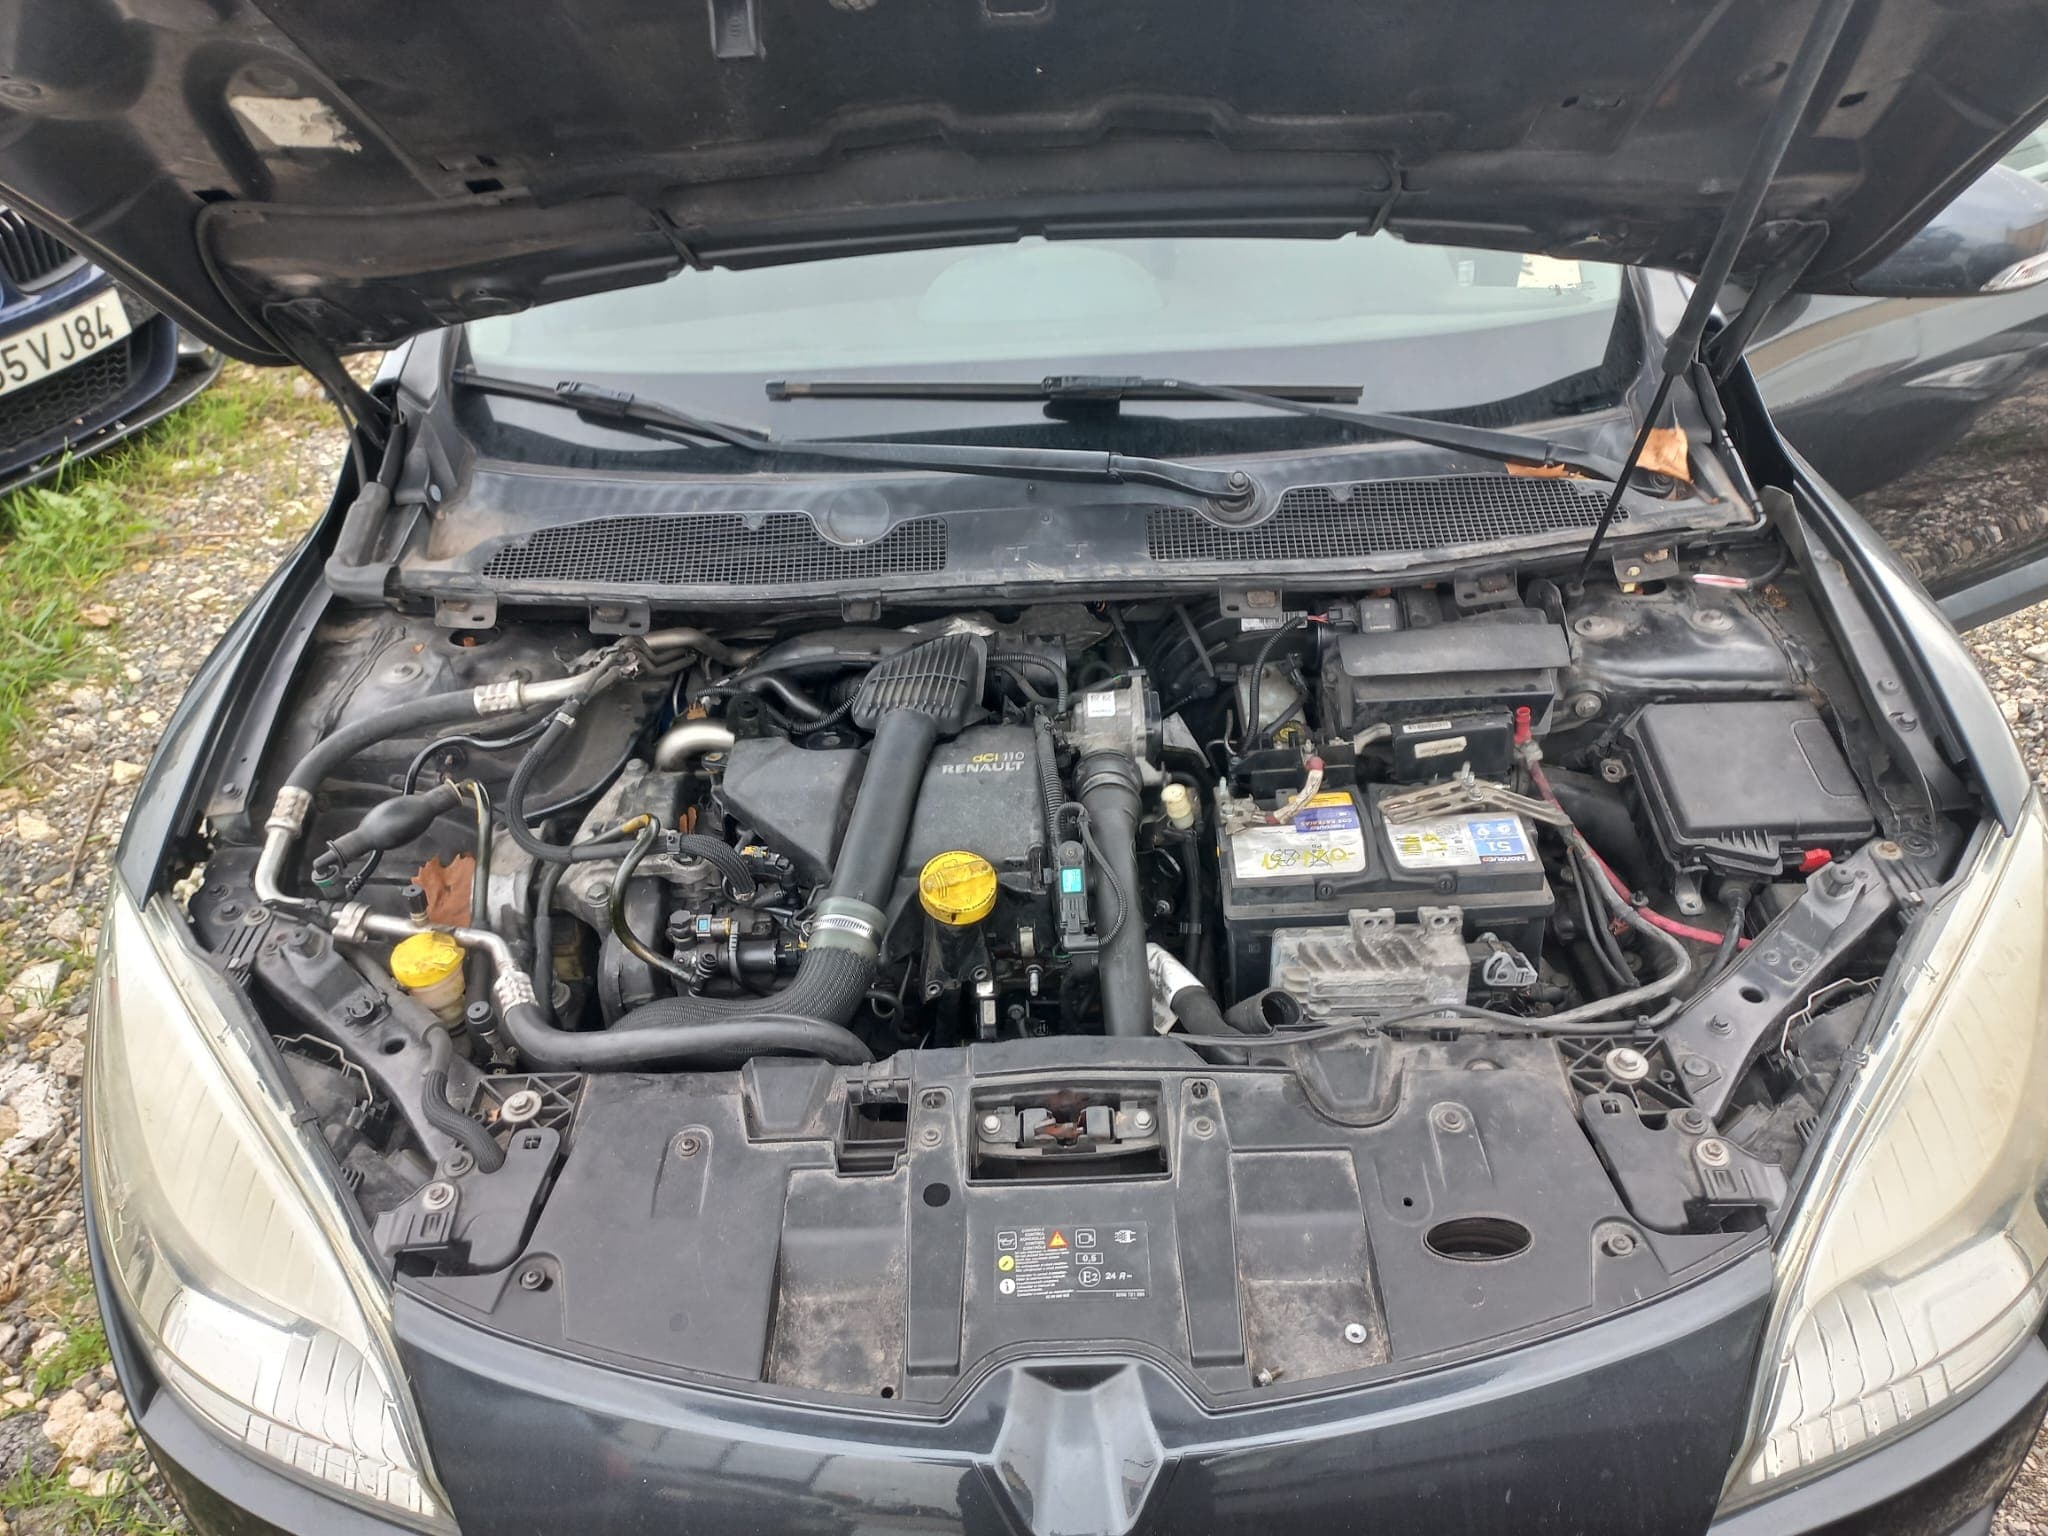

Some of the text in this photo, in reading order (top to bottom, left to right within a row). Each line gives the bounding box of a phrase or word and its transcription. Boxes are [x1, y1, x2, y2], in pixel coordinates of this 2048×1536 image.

[1002, 751, 1024, 761] 110
[942, 761, 1024, 775] RENAULT
[1487, 840, 1512, 852] 51
[1083, 1271, 1098, 1283] E2
[1104, 1271, 1117, 1280] 24
